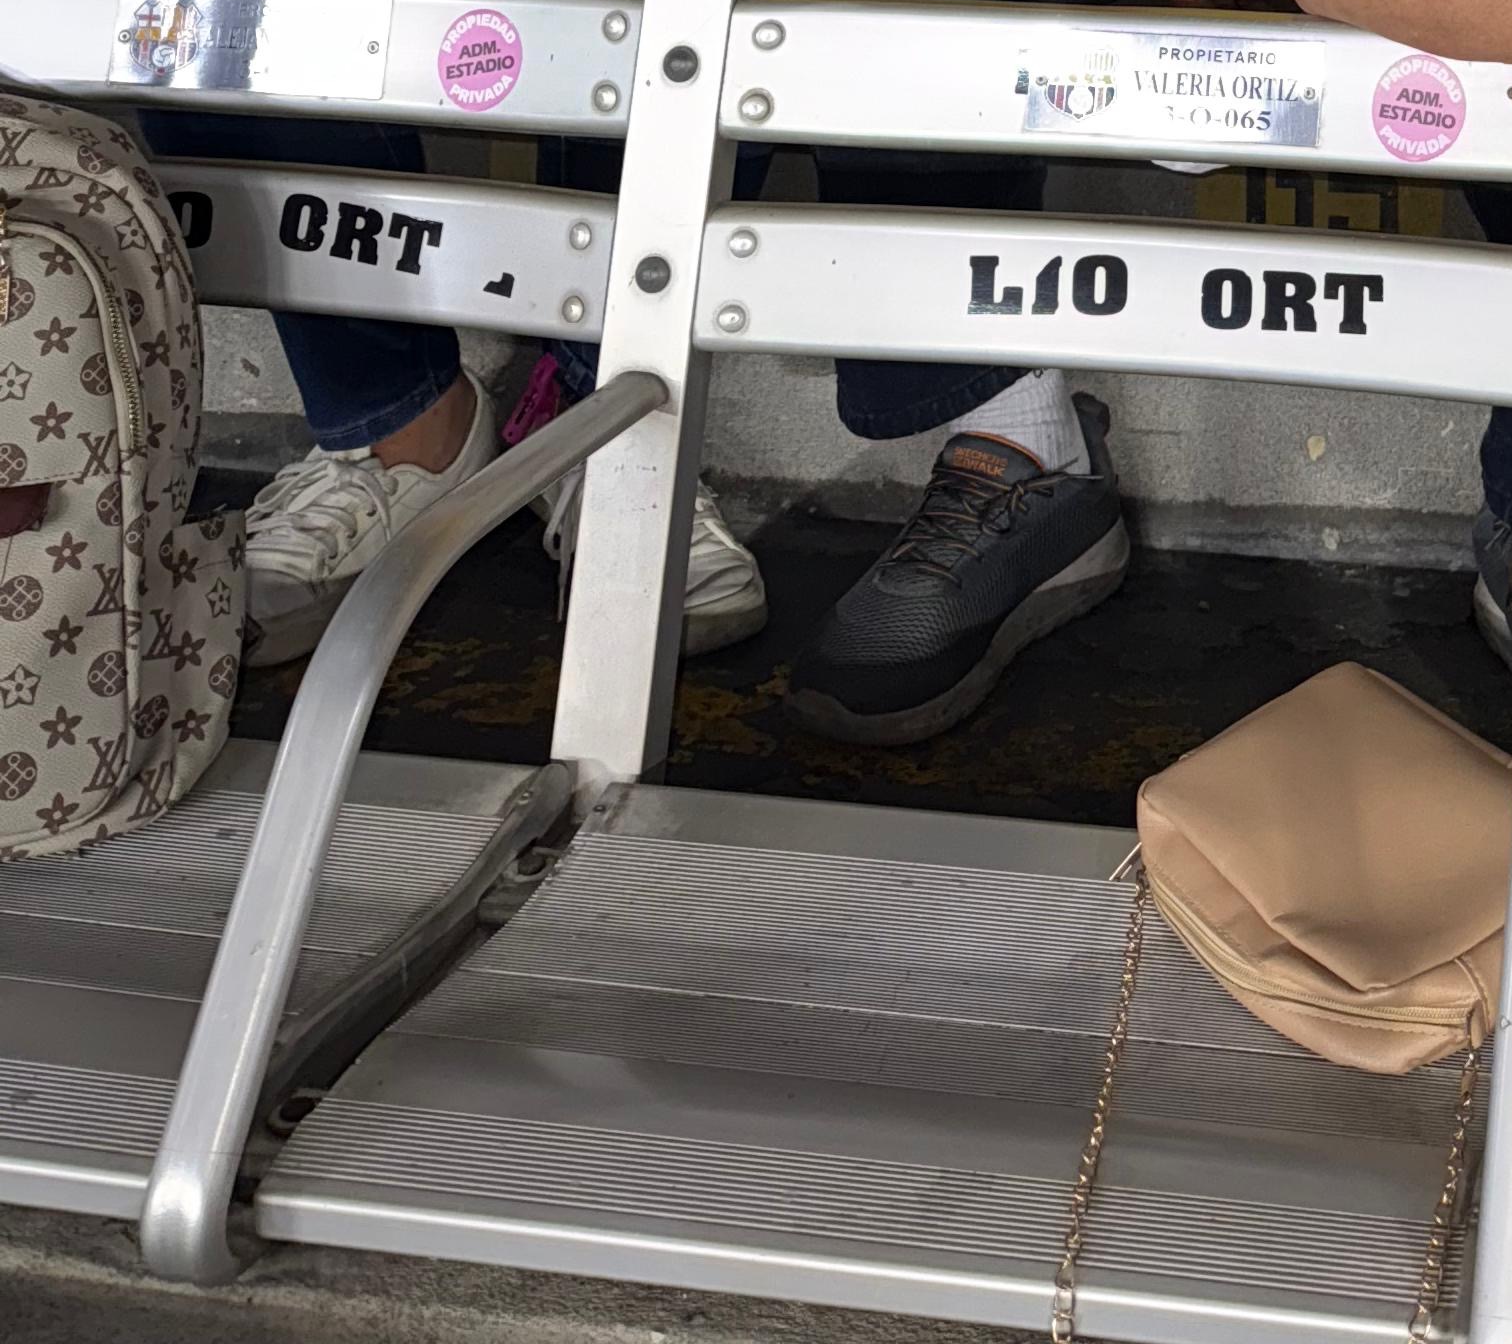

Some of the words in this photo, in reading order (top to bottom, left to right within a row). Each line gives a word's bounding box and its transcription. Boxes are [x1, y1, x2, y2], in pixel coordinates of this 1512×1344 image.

[442, 13, 516, 54] PROPIEDAD
[458, 40, 501, 60] ADM.
[1158, 46, 1276, 65] PROPIETARIO
[446, 55, 515, 79] ESTADIO
[1380, 58, 1462, 104] PROPIEDAD
[449, 75, 513, 103] PRIVADA
[1134, 70, 1226, 98] VALERIA
[1232, 75, 1299, 102] ORTIZ
[1396, 88, 1443, 108] ADM.
[1379, 103, 1456, 130] ESTADIO
[1379, 124, 1452, 155] PRIVADA
[279, 193, 443, 275] ORT
[1201, 268, 1384, 335] ORT
